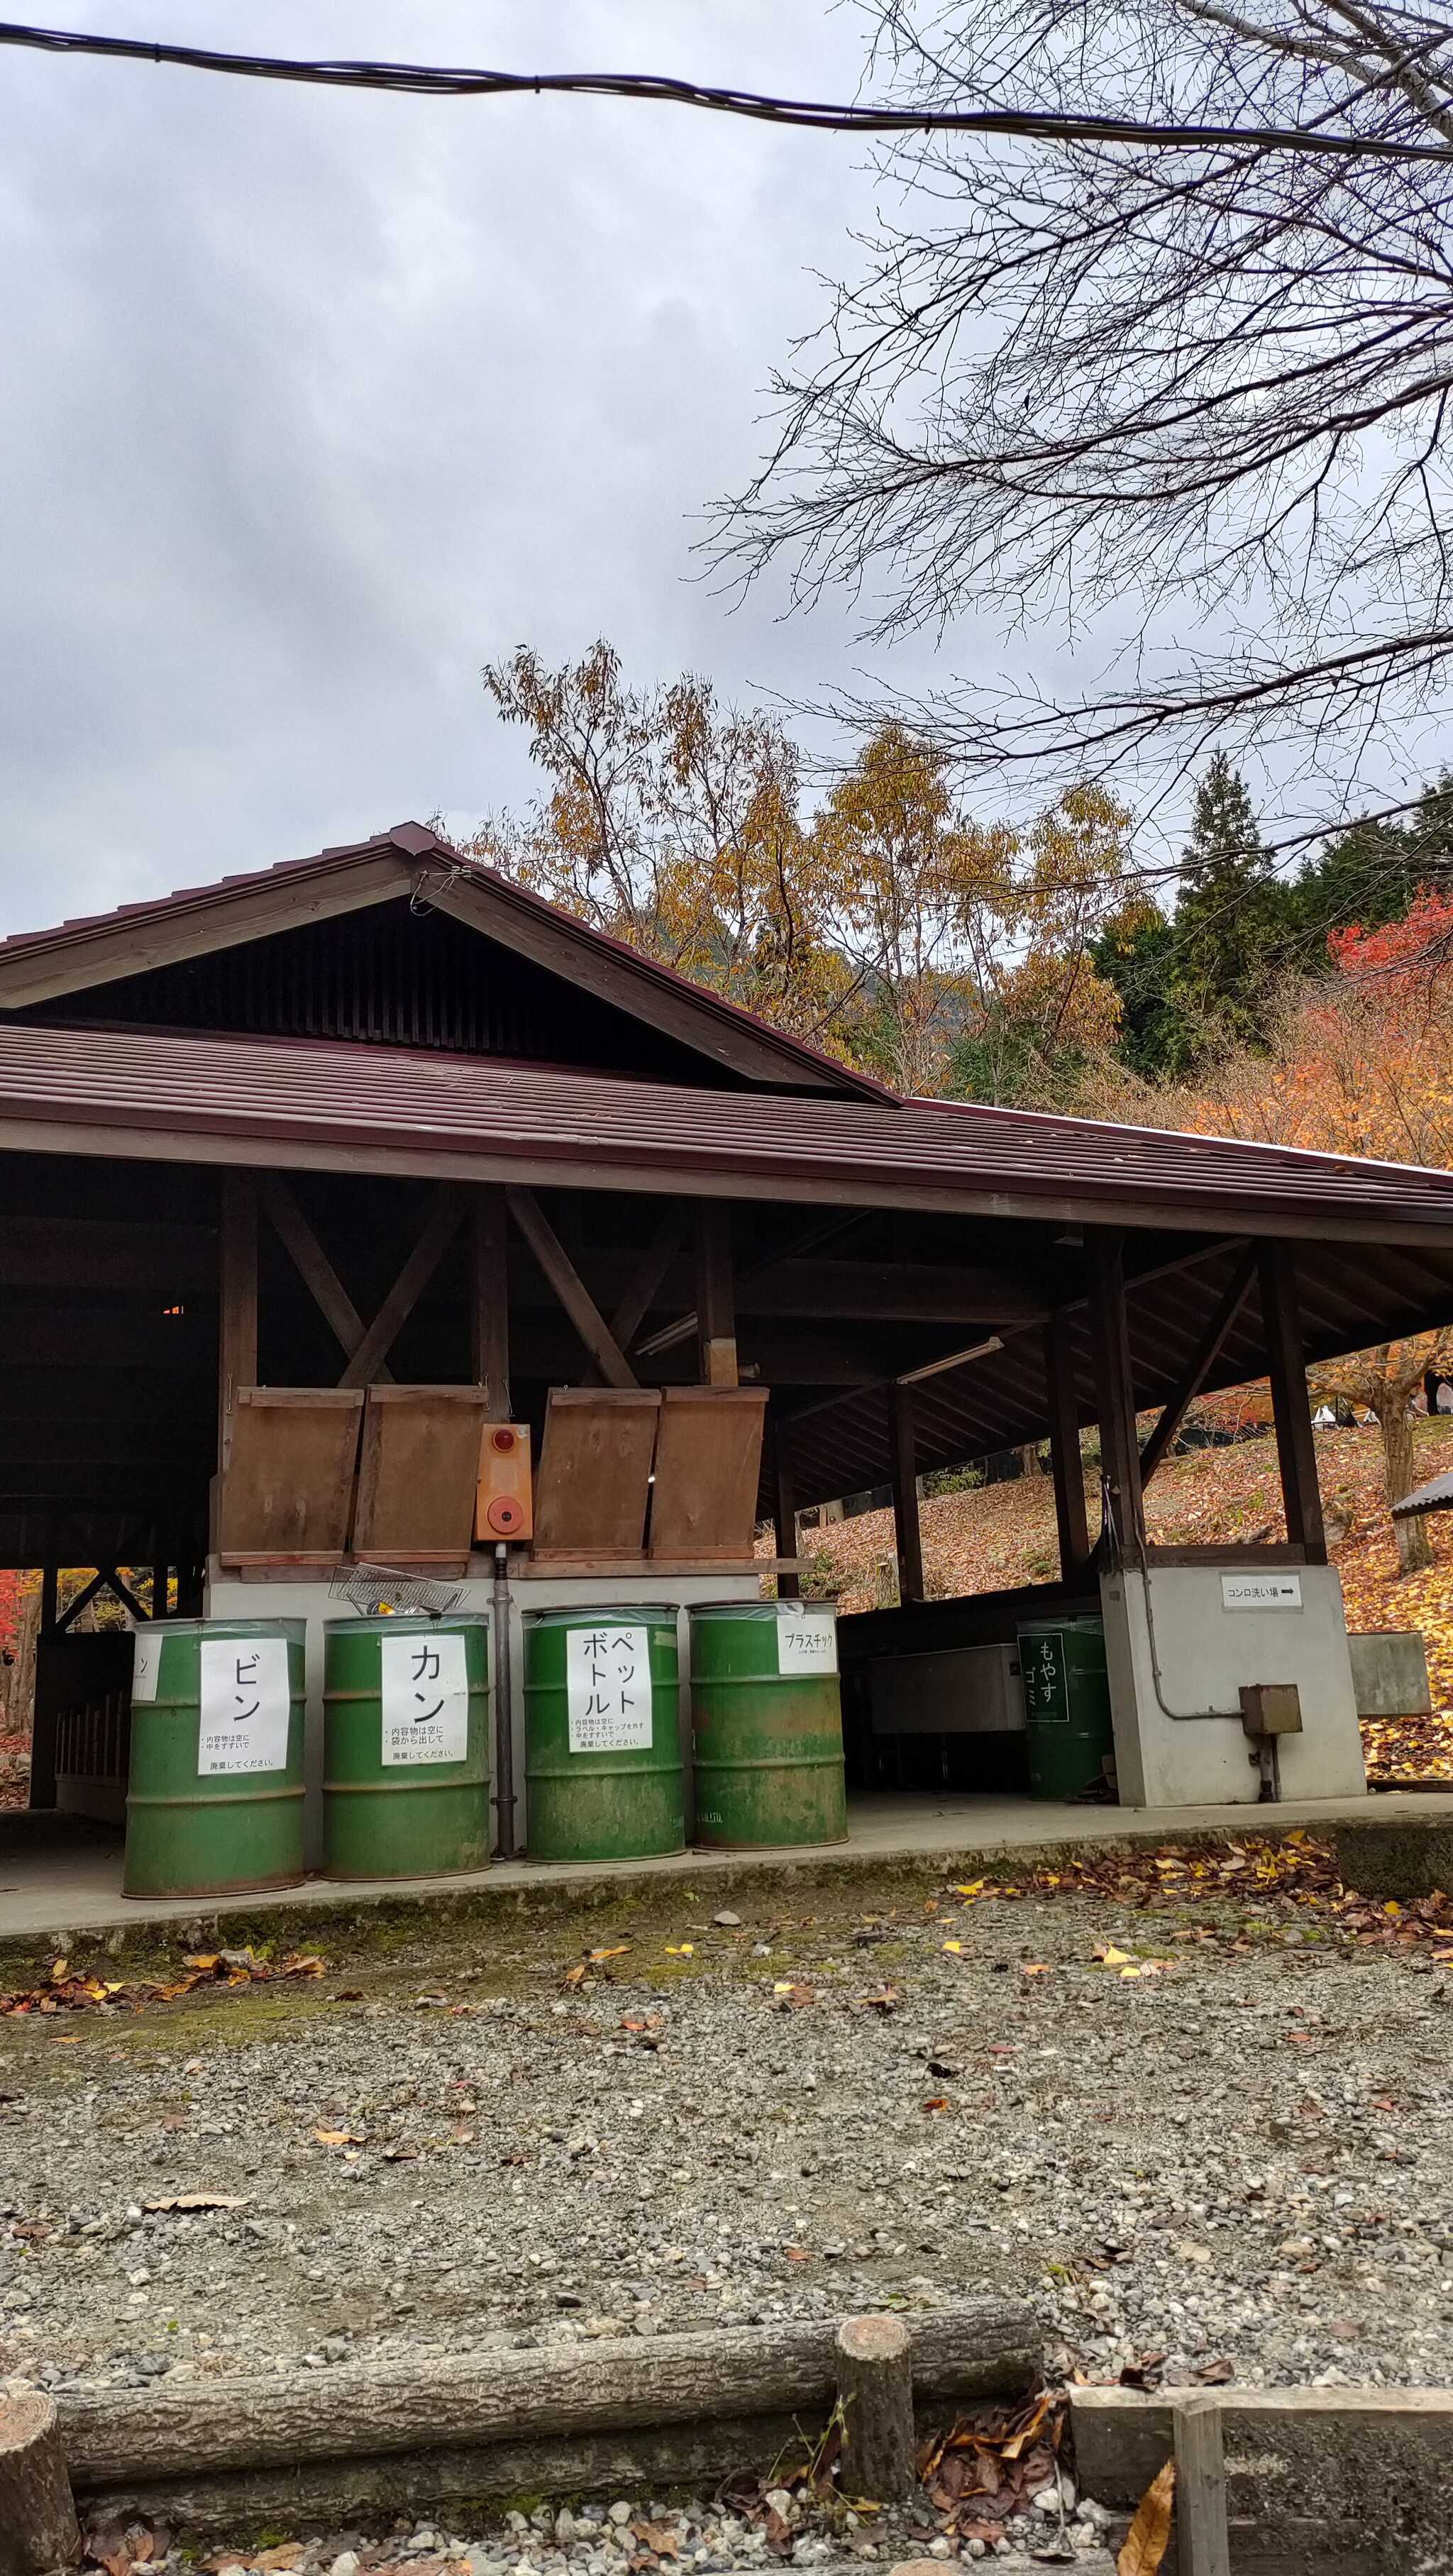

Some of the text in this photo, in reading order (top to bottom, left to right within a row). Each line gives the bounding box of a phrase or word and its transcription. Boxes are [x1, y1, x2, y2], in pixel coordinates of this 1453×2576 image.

[1227, 1587, 1278, 1598] コンロ洗い場
[785, 1632, 832, 1648] プラスチック
[233, 1654, 260, 1722] ビン
[411, 1644, 445, 1724] カン
[583, 1632, 610, 1715] ボトル
[1025, 1666, 1036, 1706] ゴミ
[1040, 1641, 1056, 1703] もやす
